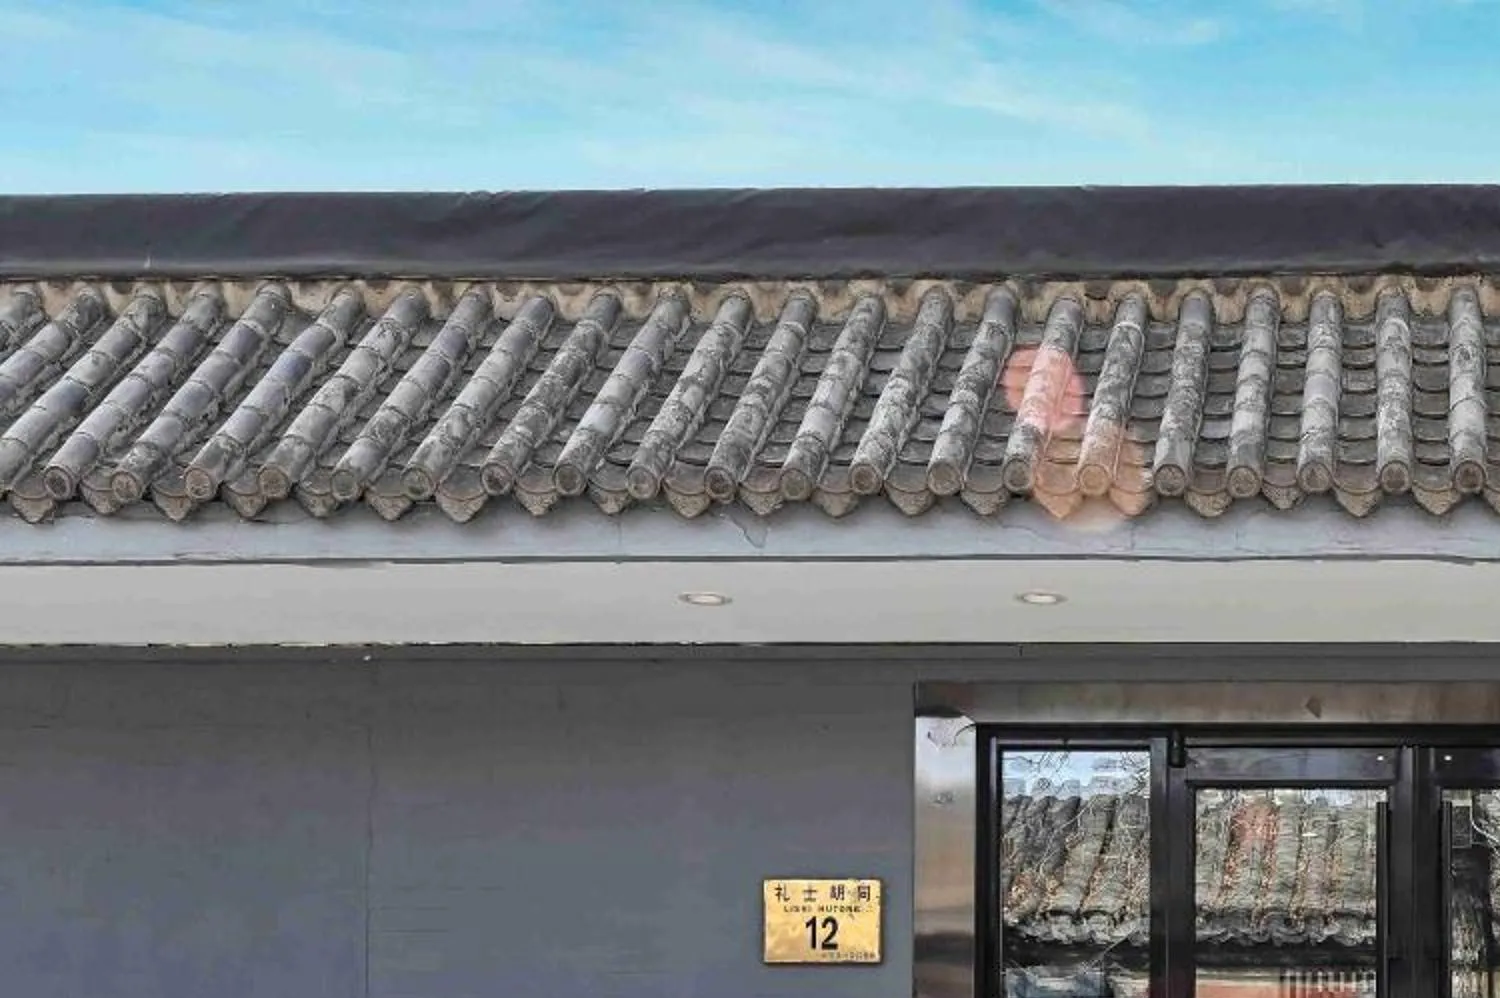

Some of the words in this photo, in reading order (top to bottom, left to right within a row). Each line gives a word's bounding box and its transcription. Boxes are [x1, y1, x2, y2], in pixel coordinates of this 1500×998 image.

[774, 883, 871, 902] 礼士胡同
[805, 916, 838, 950] 12
